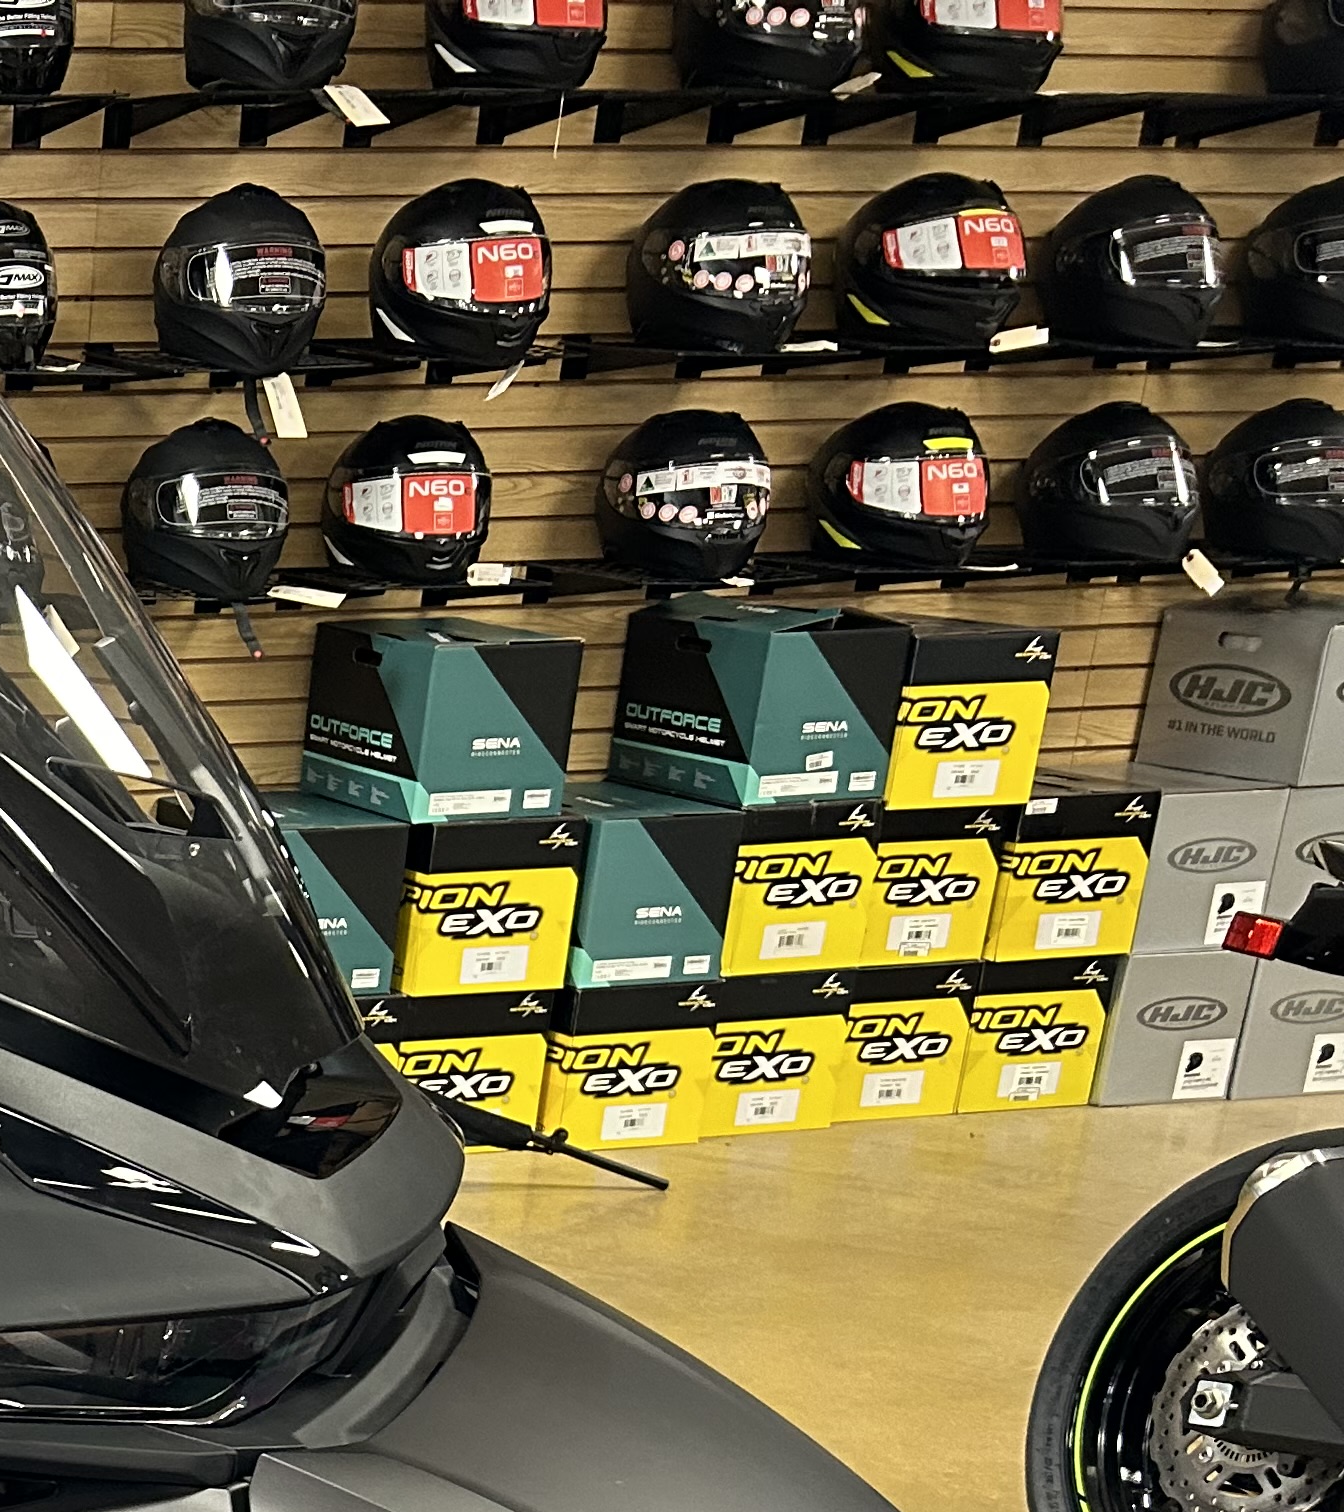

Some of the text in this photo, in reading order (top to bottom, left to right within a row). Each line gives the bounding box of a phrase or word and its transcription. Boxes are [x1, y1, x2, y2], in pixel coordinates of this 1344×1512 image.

[963, 217, 1015, 236] N60
[477, 242, 534, 264] N60
[927, 462, 978, 480] N60
[408, 479, 465, 498] N60
[1181, 673, 1278, 707] HJC
[625, 702, 723, 734] OUTFORCE
[801, 720, 848, 734] SENA
[310, 714, 394, 749] OUTFORCE
[1184, 722, 1198, 733] IN
[1200, 723, 1225, 737] THE
[1227, 727, 1277, 744] WORLD
[471, 736, 522, 751] SENA
[876, 855, 949, 878] ON
[1179, 844, 1245, 867] HJC
[635, 905, 683, 919] SENA
[1150, 1001, 1218, 1023] HJC
[846, 1014, 920, 1038] ON
